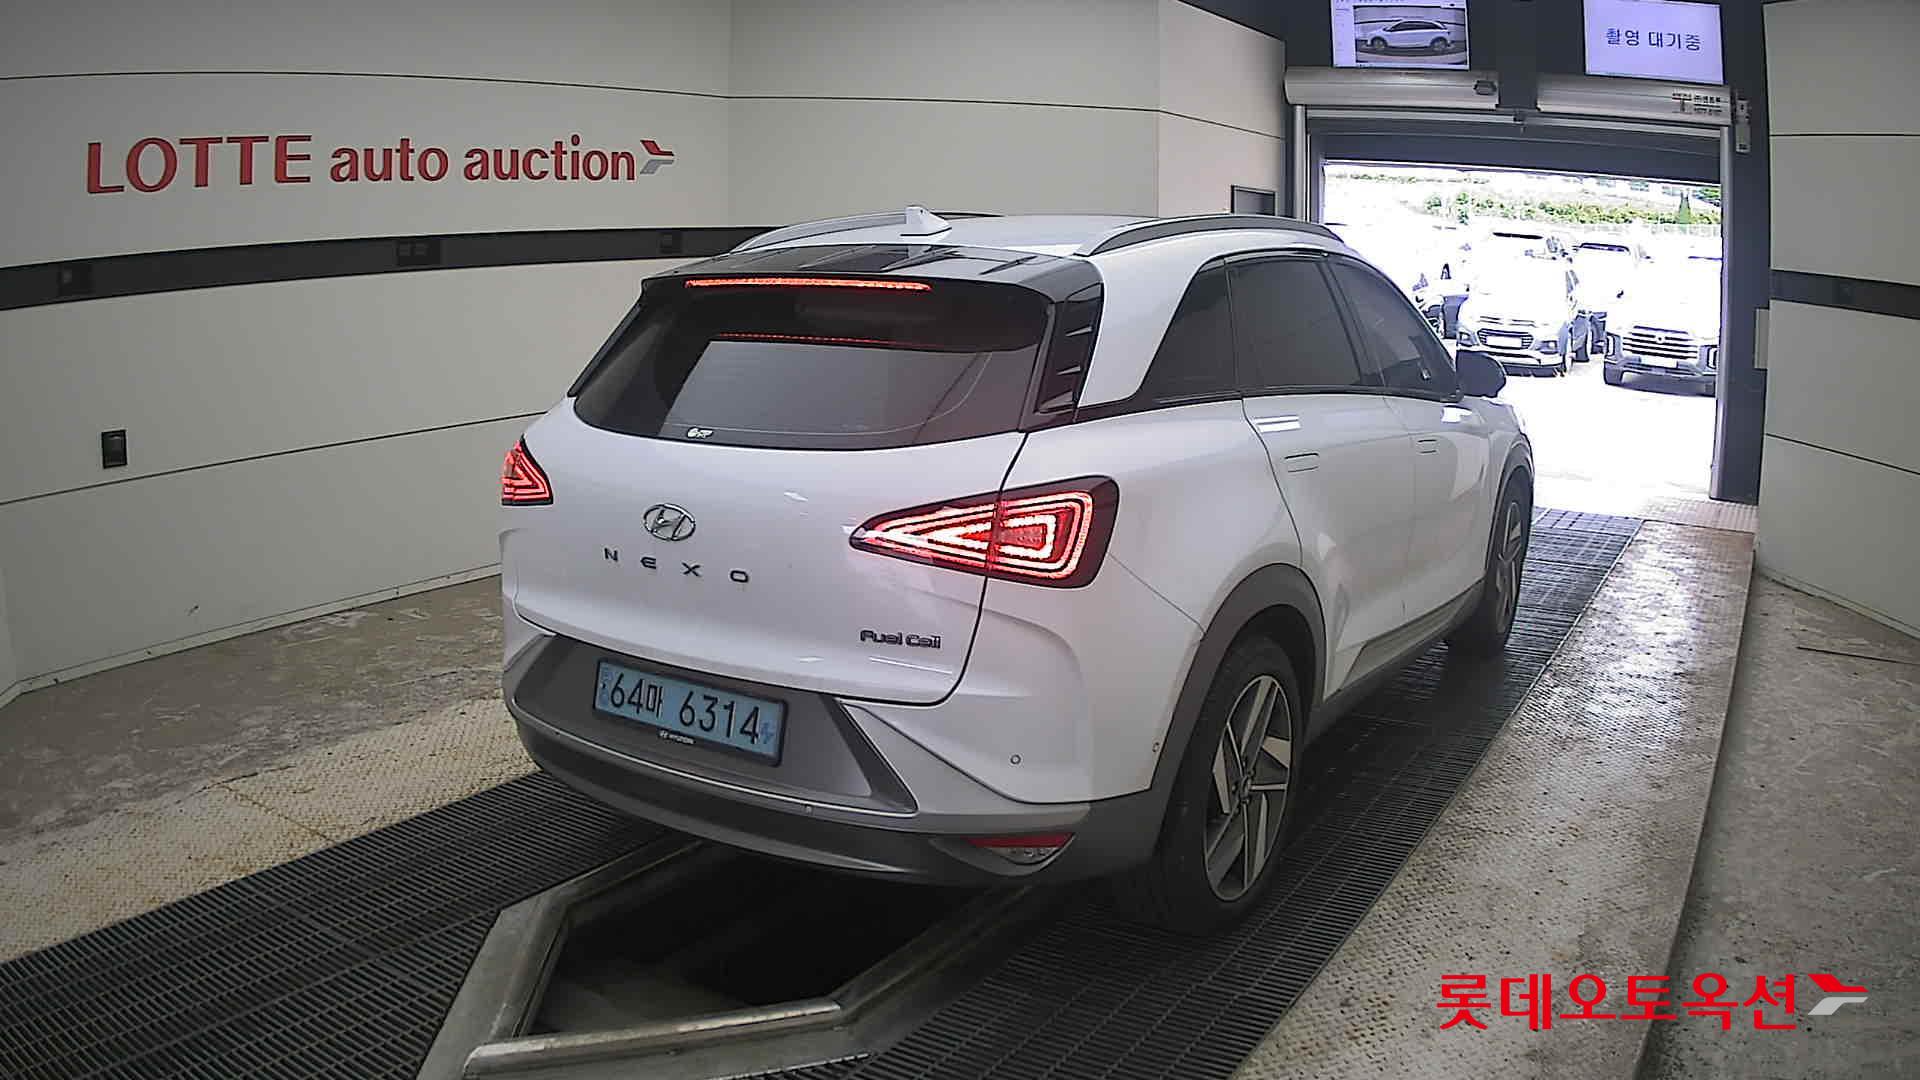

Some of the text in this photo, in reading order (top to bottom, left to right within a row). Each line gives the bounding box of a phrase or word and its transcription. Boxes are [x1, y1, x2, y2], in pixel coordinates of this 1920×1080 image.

[1647, 31, 1701, 51] 대기중
[87, 134, 636, 194] LOTTE auto auction
[604, 547, 749, 583] NEXO
[860, 629, 941, 649] Fuel Cell
[610, 672, 760, 744] 64마 6314
